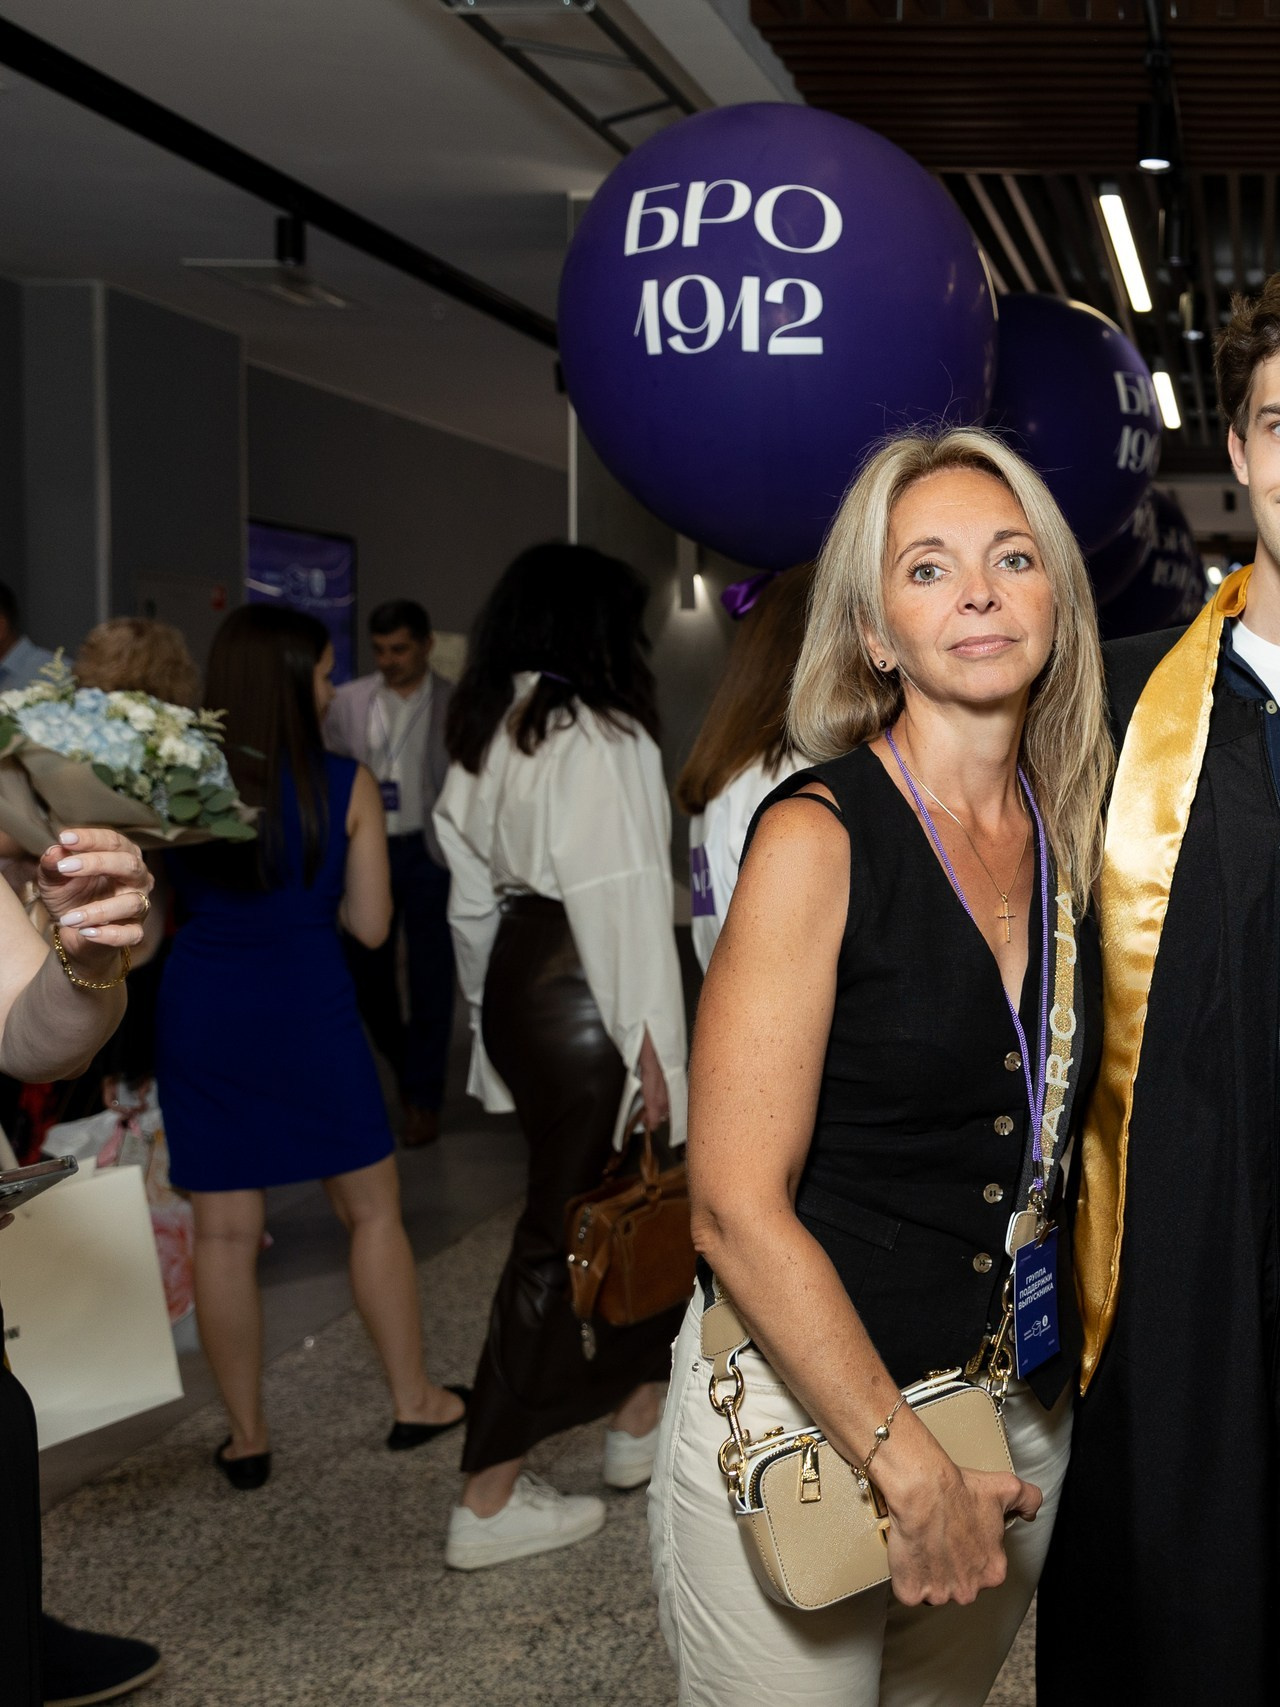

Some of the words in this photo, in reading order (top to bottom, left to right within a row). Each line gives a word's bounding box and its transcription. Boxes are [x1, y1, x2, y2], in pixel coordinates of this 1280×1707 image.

[624, 178, 844, 257] БРО
[633, 273, 825, 356] 1912
[1019, 1272, 1053, 1299] ПОДДЕРЖКИ
[1025, 1266, 1047, 1285] ГРУППА
[1018, 1282, 1054, 1310] ВЫПУСКНИКА
